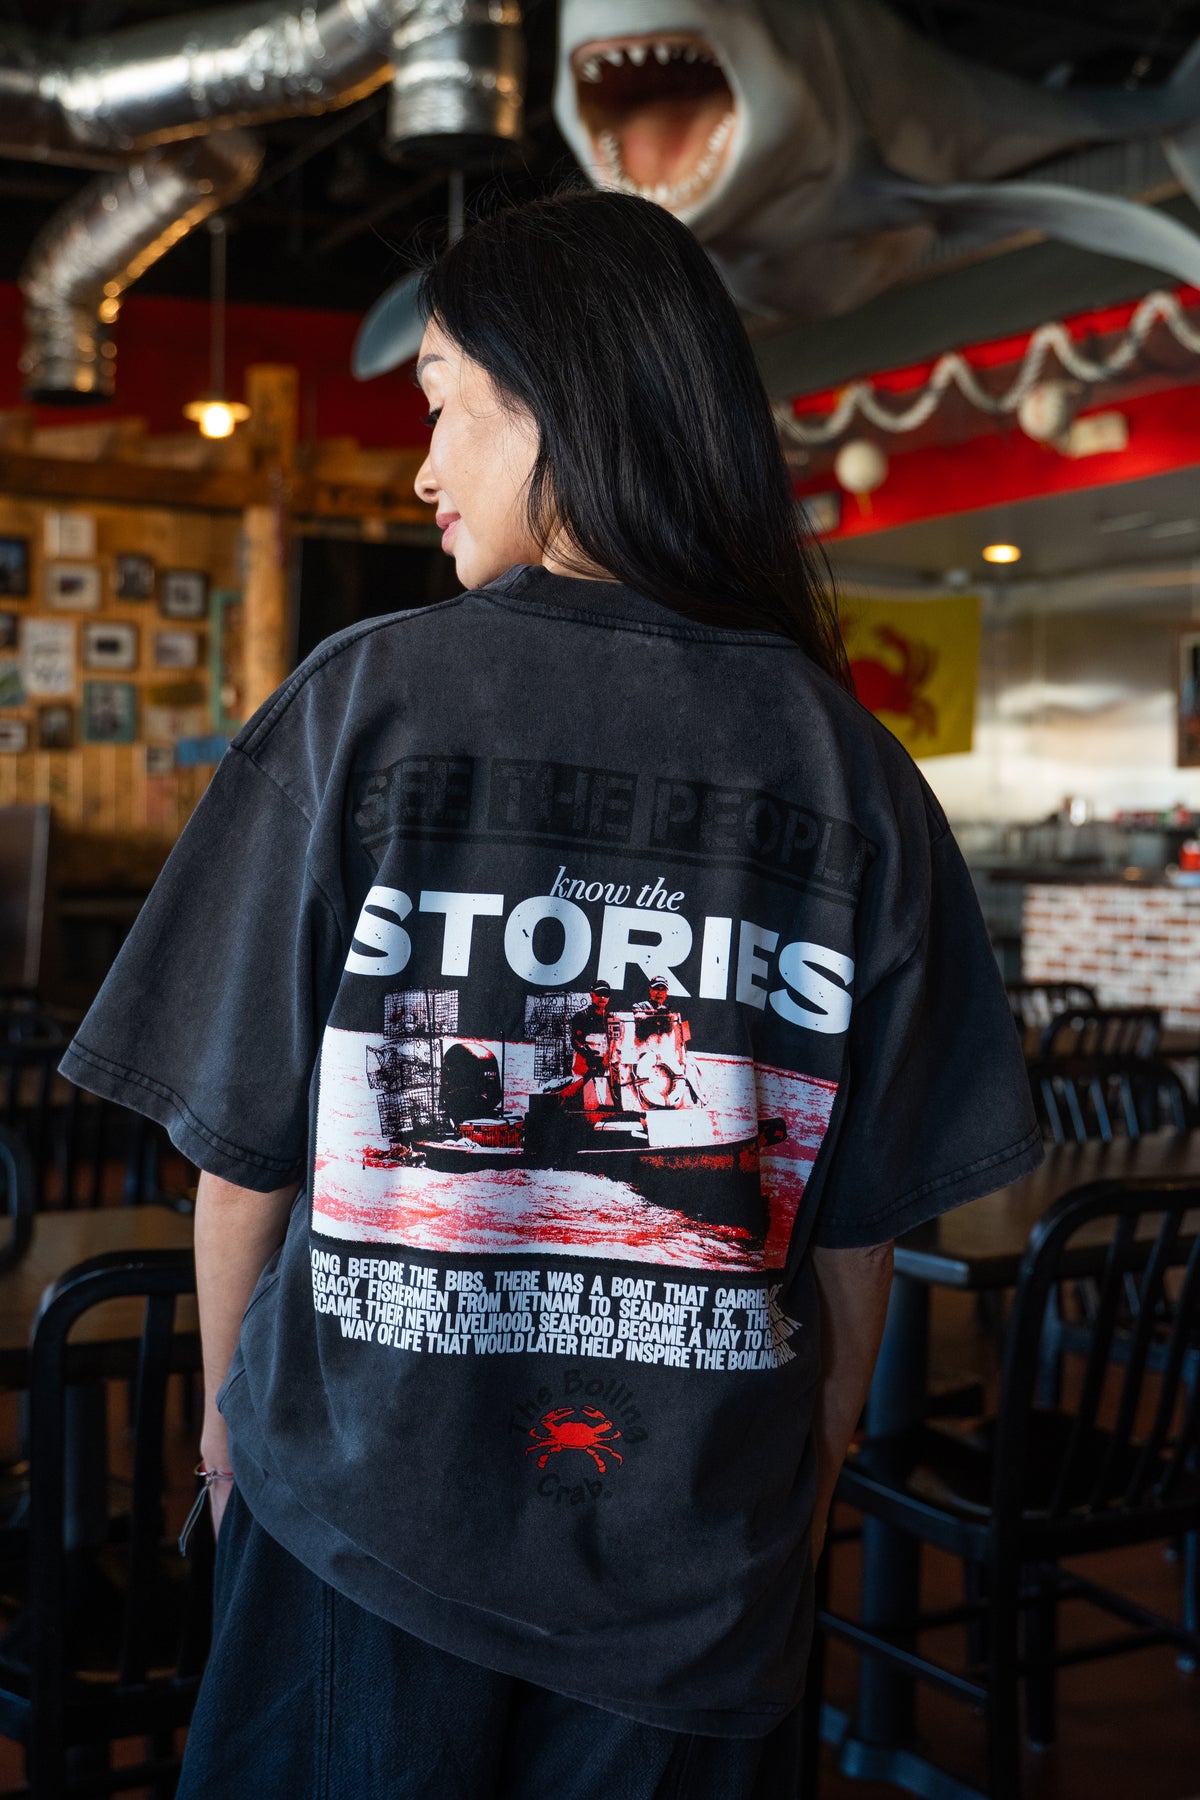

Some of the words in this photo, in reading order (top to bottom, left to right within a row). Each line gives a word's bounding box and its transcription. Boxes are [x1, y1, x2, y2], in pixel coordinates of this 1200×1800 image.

[495, 763, 634, 838] THE
[656, 778, 860, 890] PEOPL
[549, 865, 632, 906] know
[636, 877, 686, 911] the
[344, 886, 854, 1034] STORIES
[310, 1248, 341, 1276] ONG
[347, 1257, 405, 1283] BEFORE
[409, 1264, 438, 1290] THE
[494, 1270, 540, 1291] THERE
[547, 1270, 585, 1294] WAS
[591, 1275, 604, 1296] A
[611, 1276, 656, 1300] BOAT
[663, 1282, 709, 1307] THAT
[368, 1279, 449, 1312] FISHERMEN
[457, 1291, 502, 1313] FROM
[509, 1291, 580, 1314] VIETNAM
[589, 1295, 611, 1316] TO
[619, 1298, 702, 1330] SEADRIFT,
[712, 1307, 737, 1330] TX.
[340, 1316, 376, 1342] WAY
[377, 1323, 394, 1346] OF
[394, 1327, 422, 1352] LIFE
[426, 1331, 472, 1355] THAT
[474, 1333, 524, 1355] WOULD
[526, 1333, 577, 1356] LATER
[581, 1337, 624, 1359] HELP
[626, 1340, 690, 1369] INSPIRE
[694, 1349, 725, 1371] THE
[406, 1310, 442, 1332] NEW
[445, 1312, 536, 1334] LIVELIHOOD,
[539, 1312, 615, 1338] SEAFOOD
[618, 1318, 685, 1346] BECAME
[690, 1326, 702, 1348] A
[706, 1328, 742, 1349] WAY
[744, 1330, 762, 1349] TO
[564, 1369, 647, 1444] Boiling
